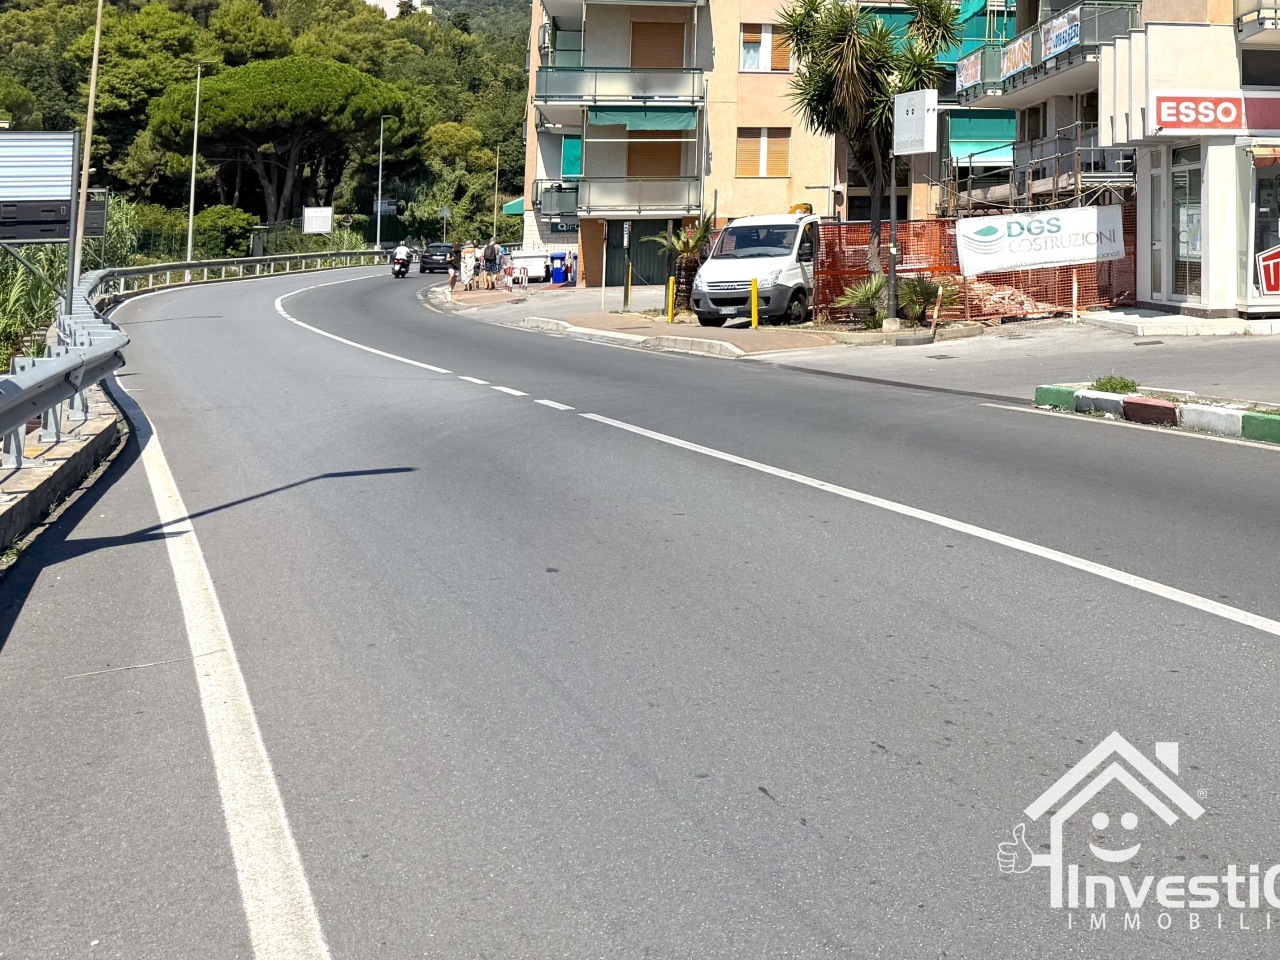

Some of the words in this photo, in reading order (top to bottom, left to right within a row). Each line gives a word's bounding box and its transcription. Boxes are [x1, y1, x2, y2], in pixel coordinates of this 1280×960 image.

[1160, 101, 1237, 123] ESSO
[1006, 217, 1062, 238] DGS
[1008, 228, 1116, 254] COSTRUZIONI
